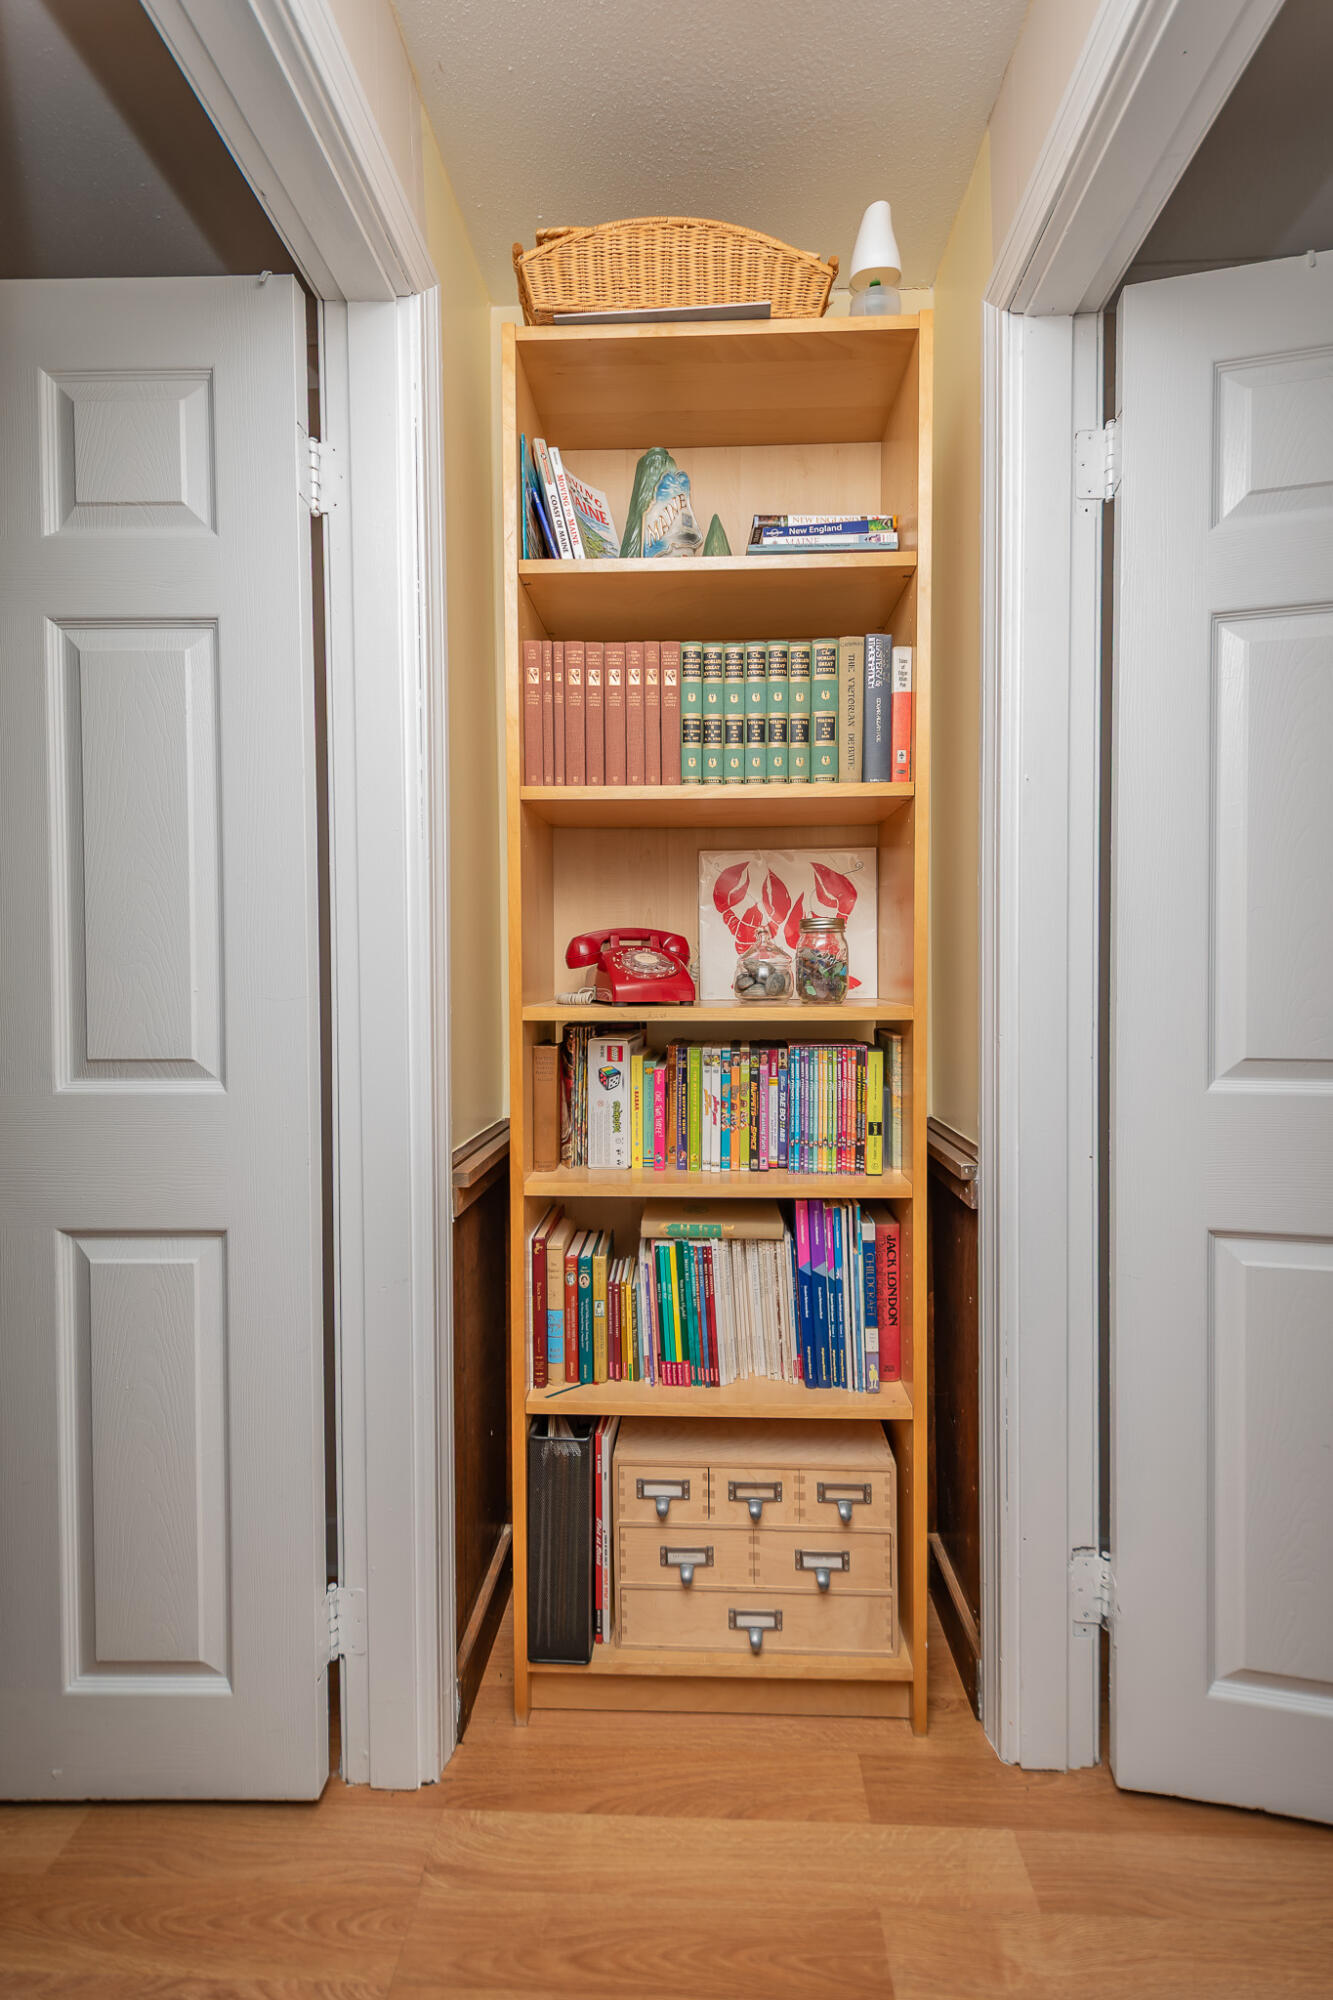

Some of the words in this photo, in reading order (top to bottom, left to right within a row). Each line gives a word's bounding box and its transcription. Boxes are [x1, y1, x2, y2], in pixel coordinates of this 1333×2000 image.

[550, 494, 560, 518] COAST
[557, 474, 570, 507] MOVING
[568, 518, 580, 546] MAINE
[648, 493, 687, 548] MAINE
[556, 519, 563, 529] OF
[559, 529, 569, 553] MAINE
[785, 537, 821, 545] MAINE
[789, 527, 808, 535] New
[808, 524, 843, 535] England
[847, 654, 856, 673] THE
[846, 677, 856, 727] VICTORIAN
[847, 733, 856, 770] DEBATE
[750, 1081, 758, 1116] MUPPETS
[750, 1125, 758, 1151] SPACE
[886, 1234, 897, 1268] JACK
[865, 1252, 875, 1317] CHILDCRAFT
[887, 1271, 898, 1327] LONDON
